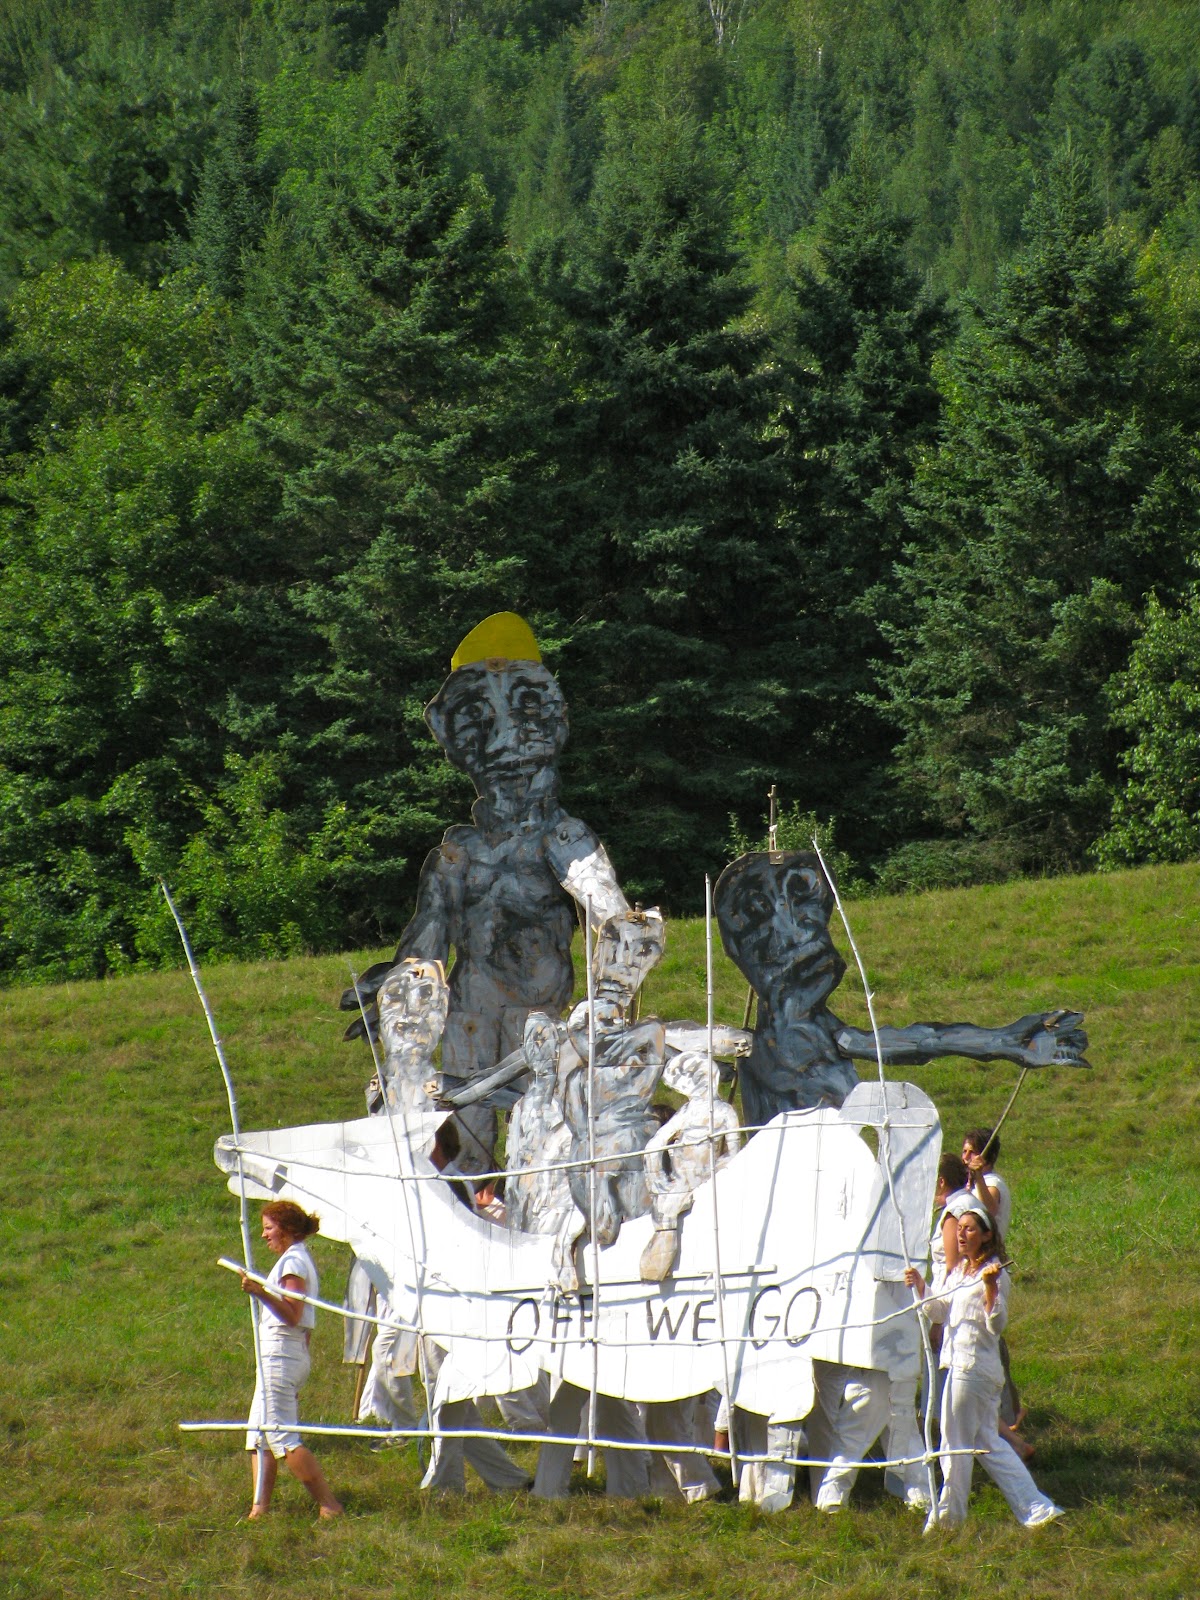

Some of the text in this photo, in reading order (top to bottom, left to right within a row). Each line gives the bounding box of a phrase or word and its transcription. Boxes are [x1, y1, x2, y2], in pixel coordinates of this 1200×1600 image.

[506, 1285, 821, 1355] OFF WE GO
